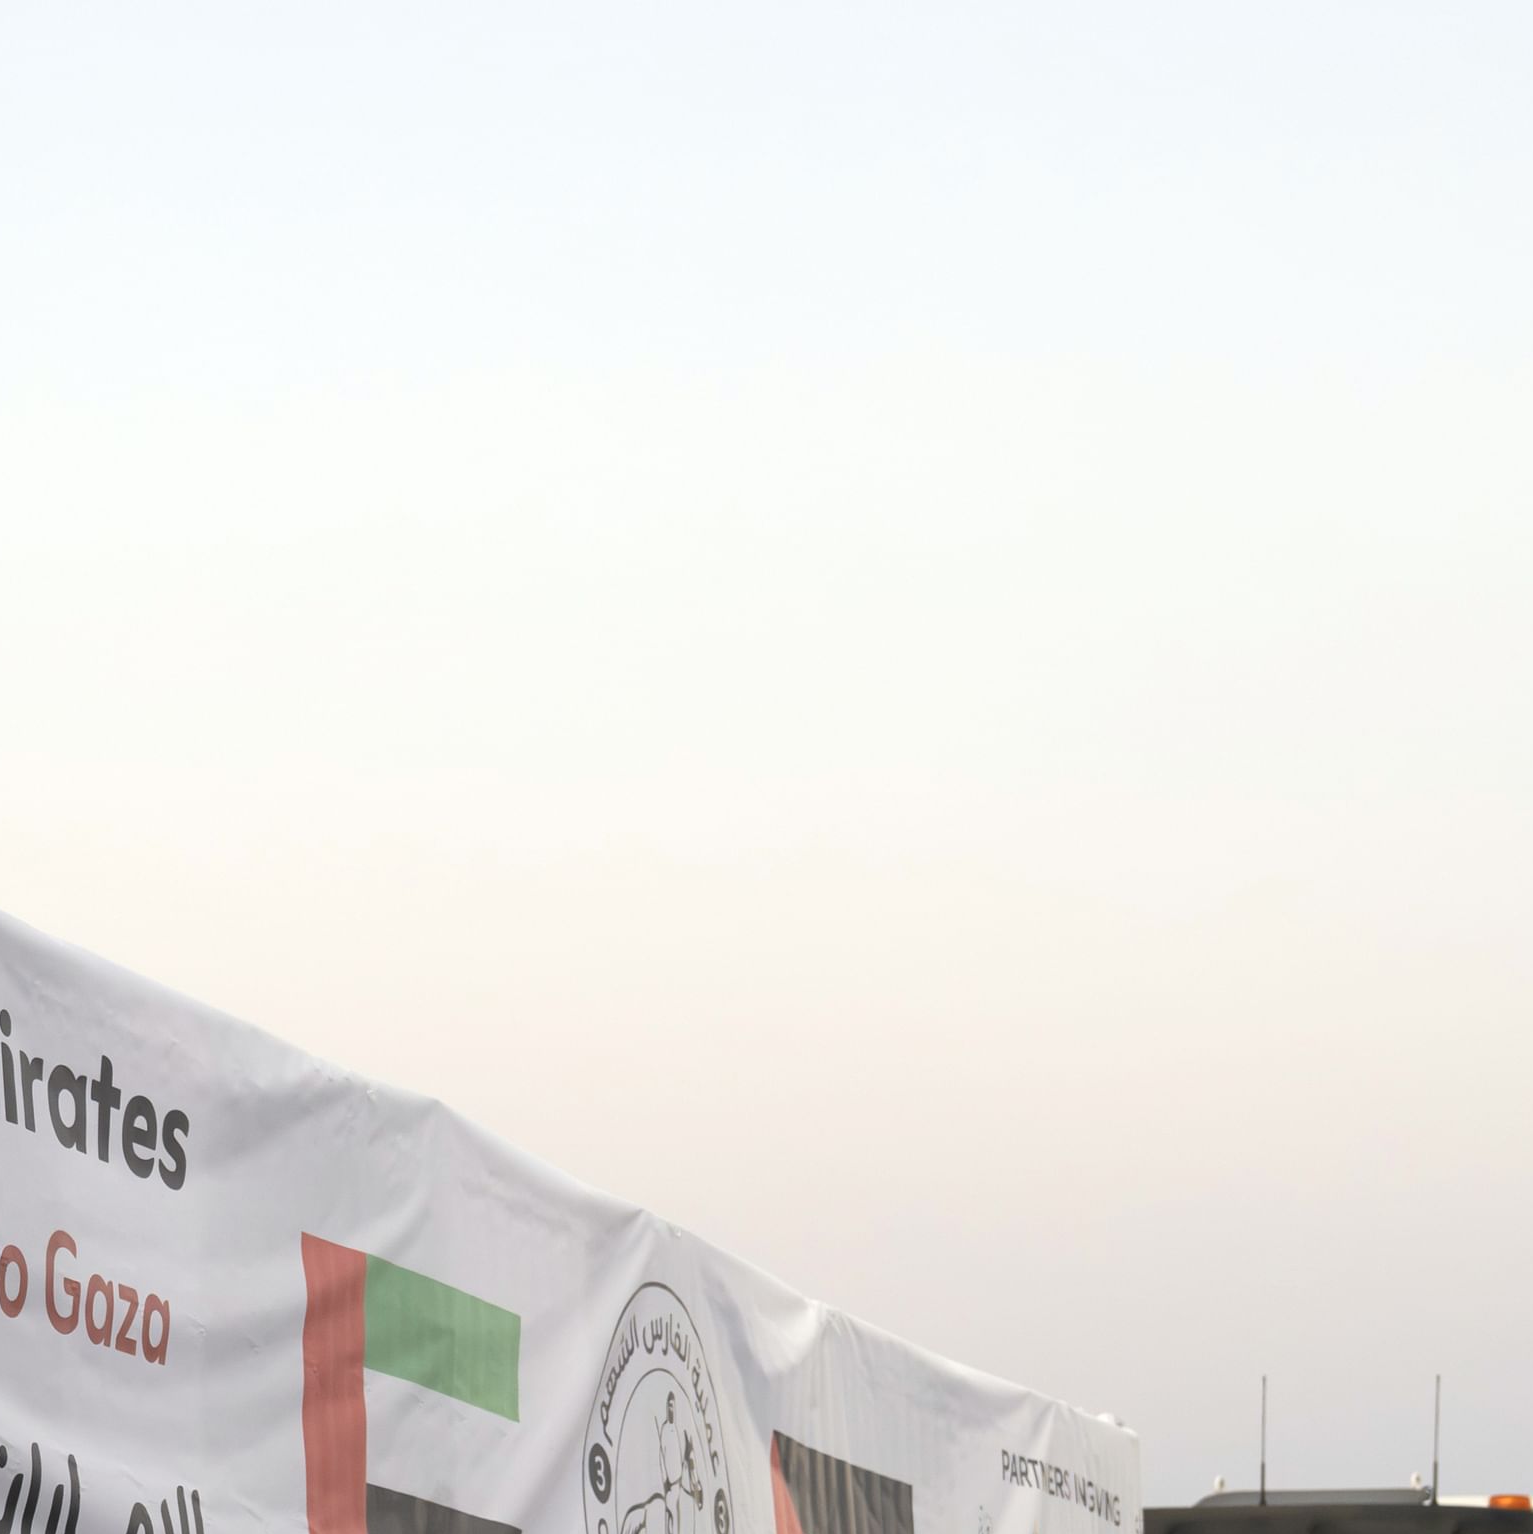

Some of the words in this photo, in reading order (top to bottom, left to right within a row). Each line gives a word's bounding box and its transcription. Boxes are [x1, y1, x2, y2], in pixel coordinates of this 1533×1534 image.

[45, 1230, 169, 1366] Gaza
[642, 1312, 692, 1371] الفارس
[600, 1313, 640, 1448] الشهم
[691, 1358, 720, 1477] عملية
[1001, 1449, 1072, 1500] PARTNERS
